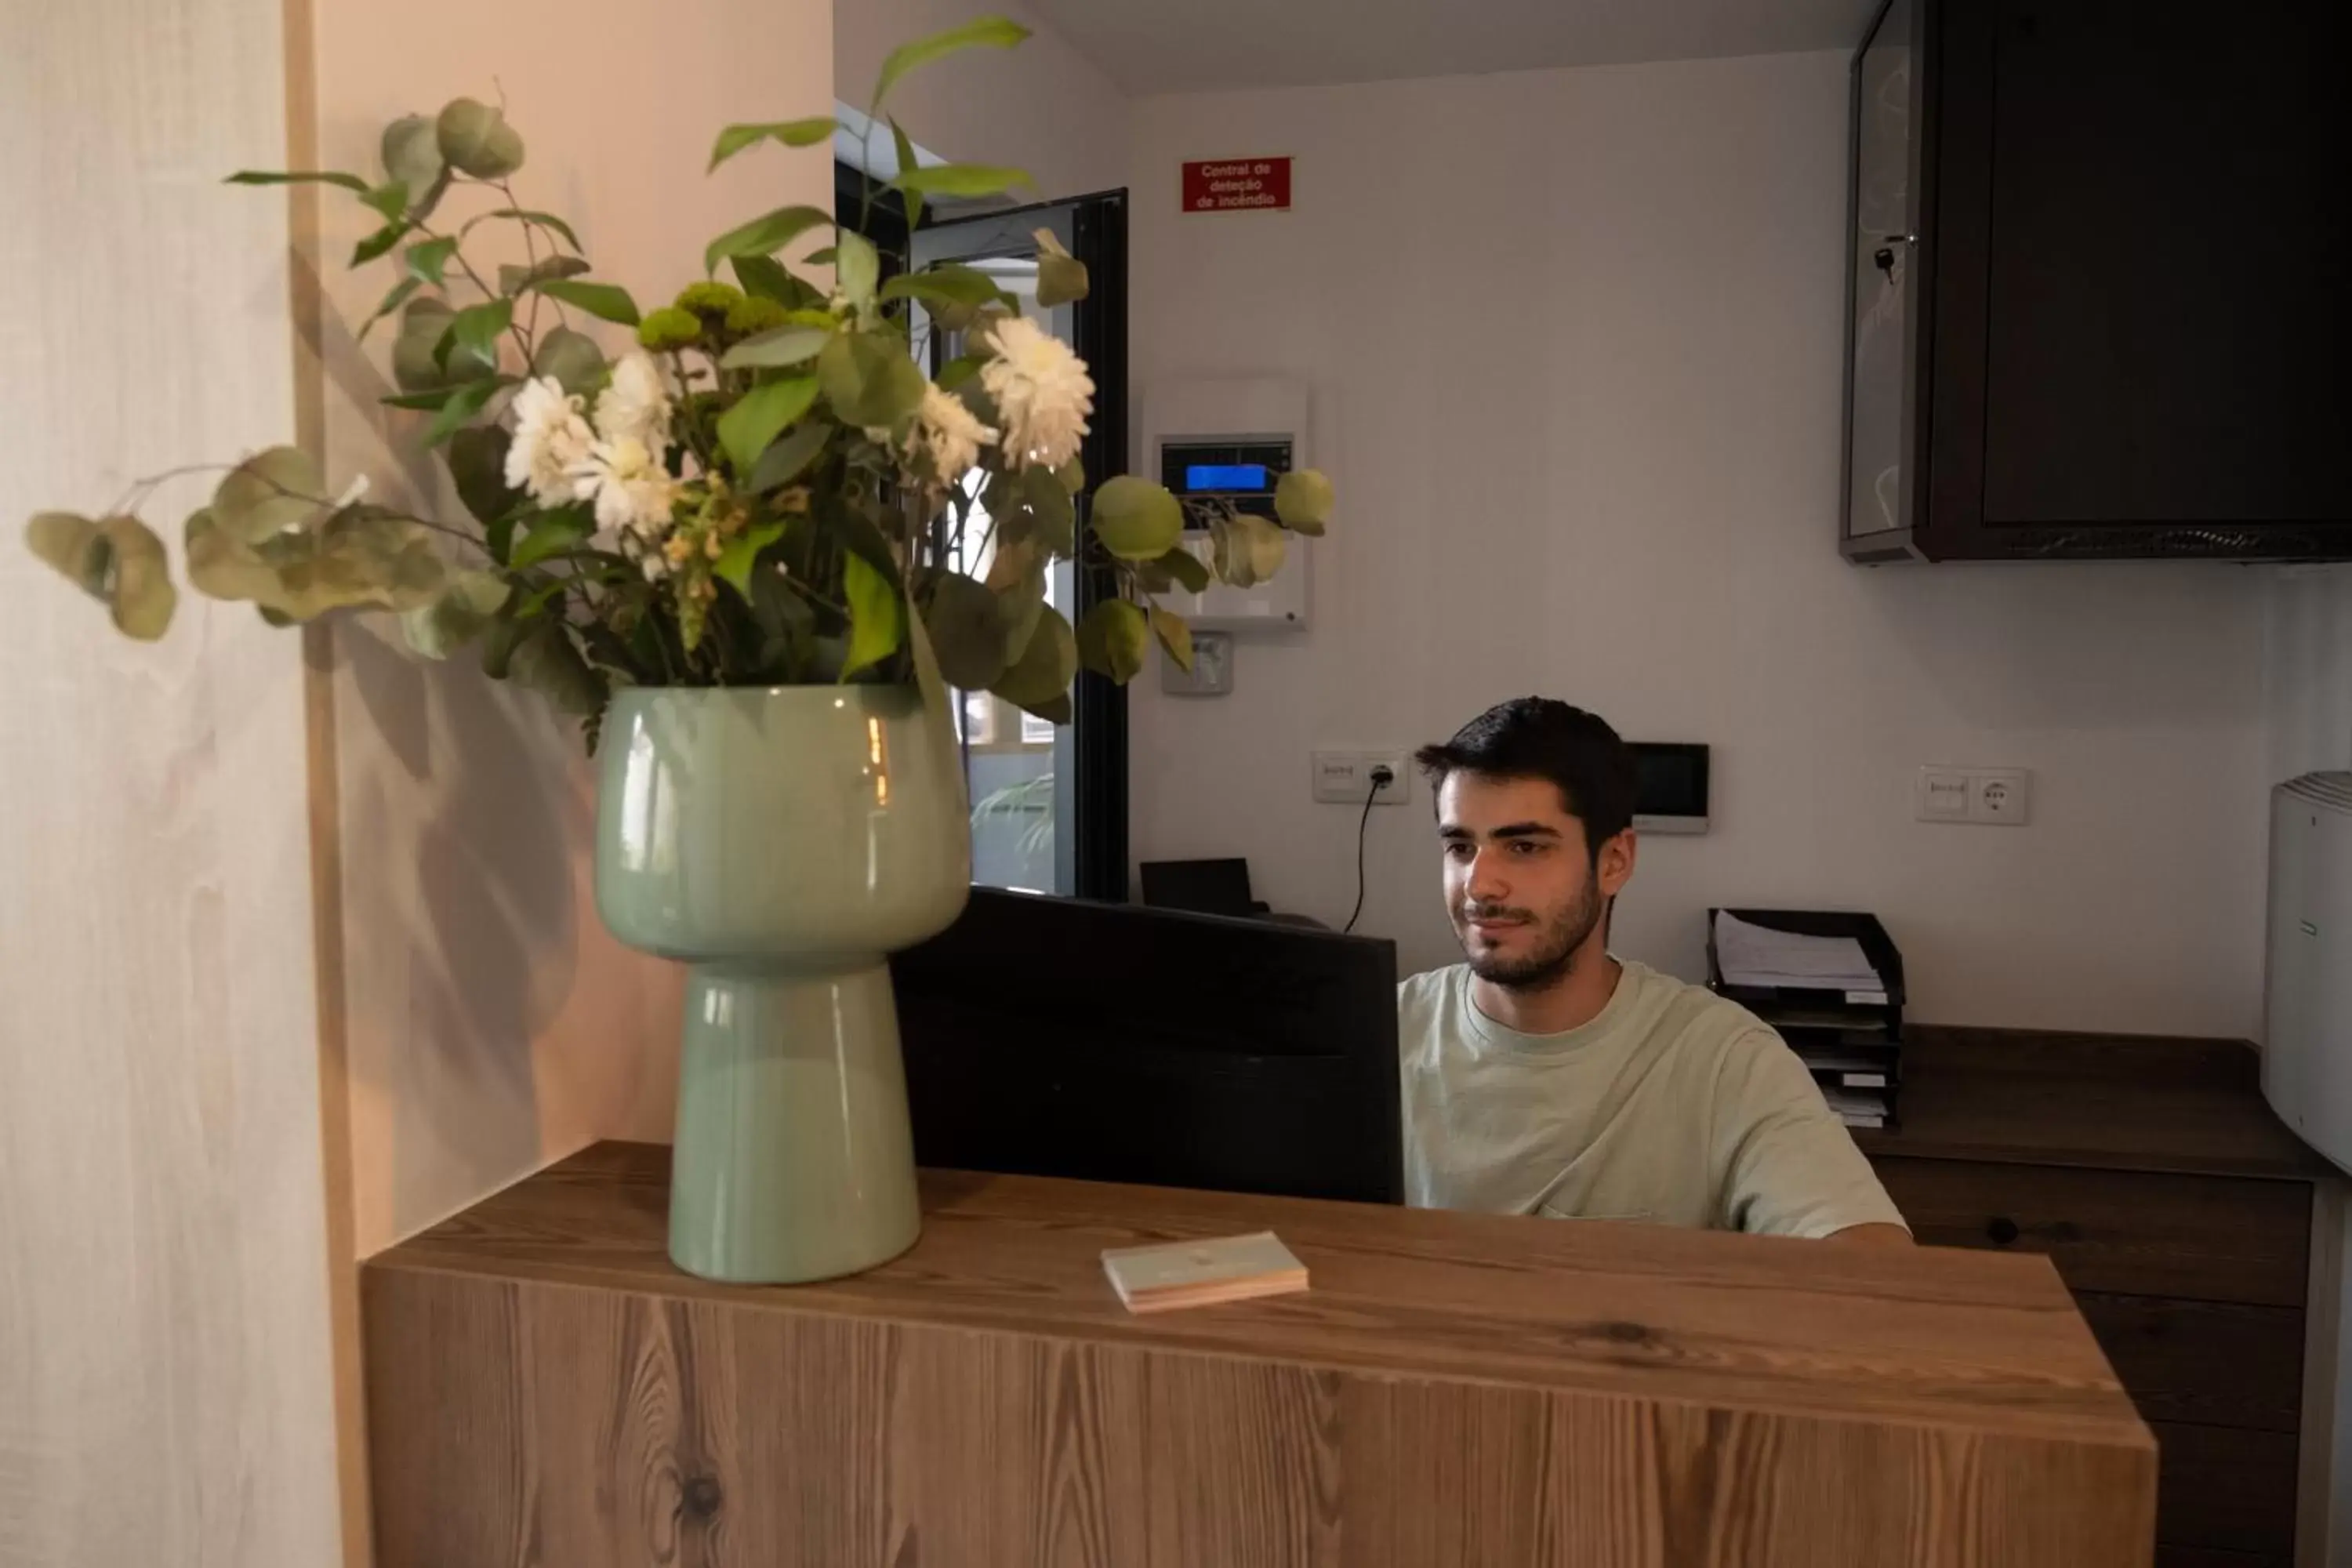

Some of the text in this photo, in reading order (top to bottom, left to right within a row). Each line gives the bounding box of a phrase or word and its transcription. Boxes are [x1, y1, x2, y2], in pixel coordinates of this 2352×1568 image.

[1202, 163, 1271, 177] Central de
[1196, 196, 1214, 208] de
